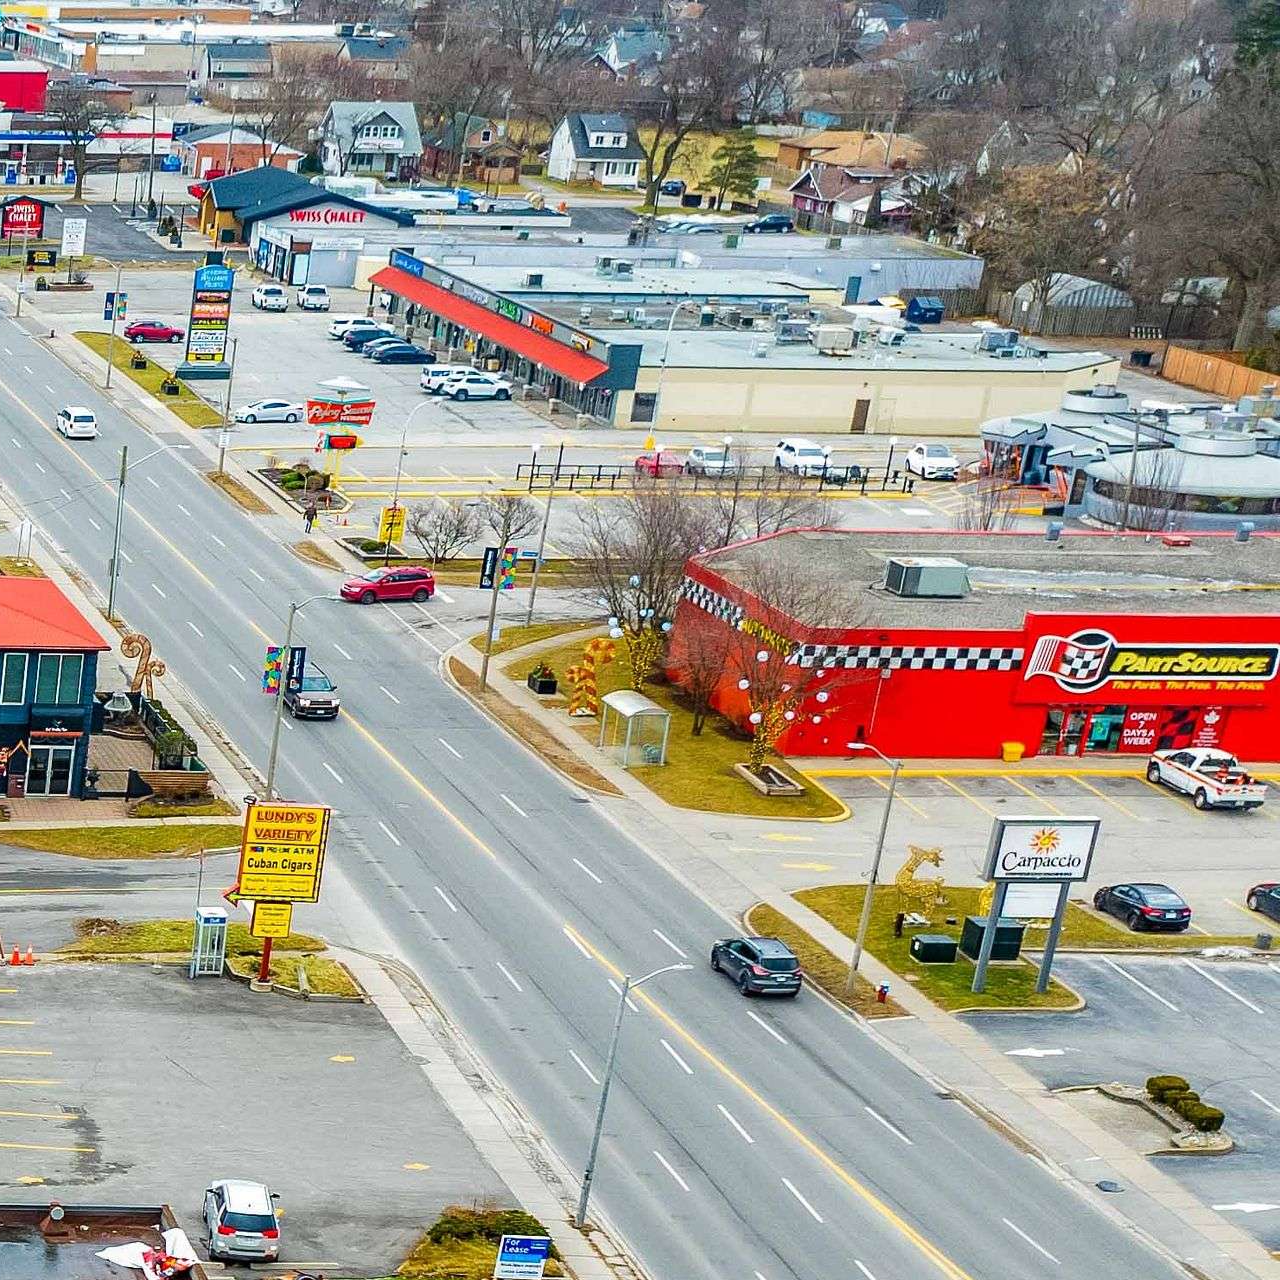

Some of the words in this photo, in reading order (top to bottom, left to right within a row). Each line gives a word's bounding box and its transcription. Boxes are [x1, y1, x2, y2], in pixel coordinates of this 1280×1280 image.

[13, 205, 35, 213] SWISS
[9, 213, 37, 222] CHALET
[290, 209, 321, 222] SWISS
[324, 208, 366, 224] CHALET
[1130, 712, 1157, 721] OPEN
[1138, 721, 1145, 729] 7
[1123, 729, 1145, 737] DAYS
[1147, 729, 1155, 737] A
[1123, 737, 1152, 745] WEEK
[256, 810, 317, 824] LUNDY'S
[254, 828, 317, 842] VARIETY
[293, 847, 315, 855] ATM
[247, 858, 278, 869] Cuban
[281, 859, 312, 872] Cigars
[1001, 851, 1082, 871] Carpaccio
[505, 1238, 520, 1246] For
[504, 1245, 529, 1254] Lease
